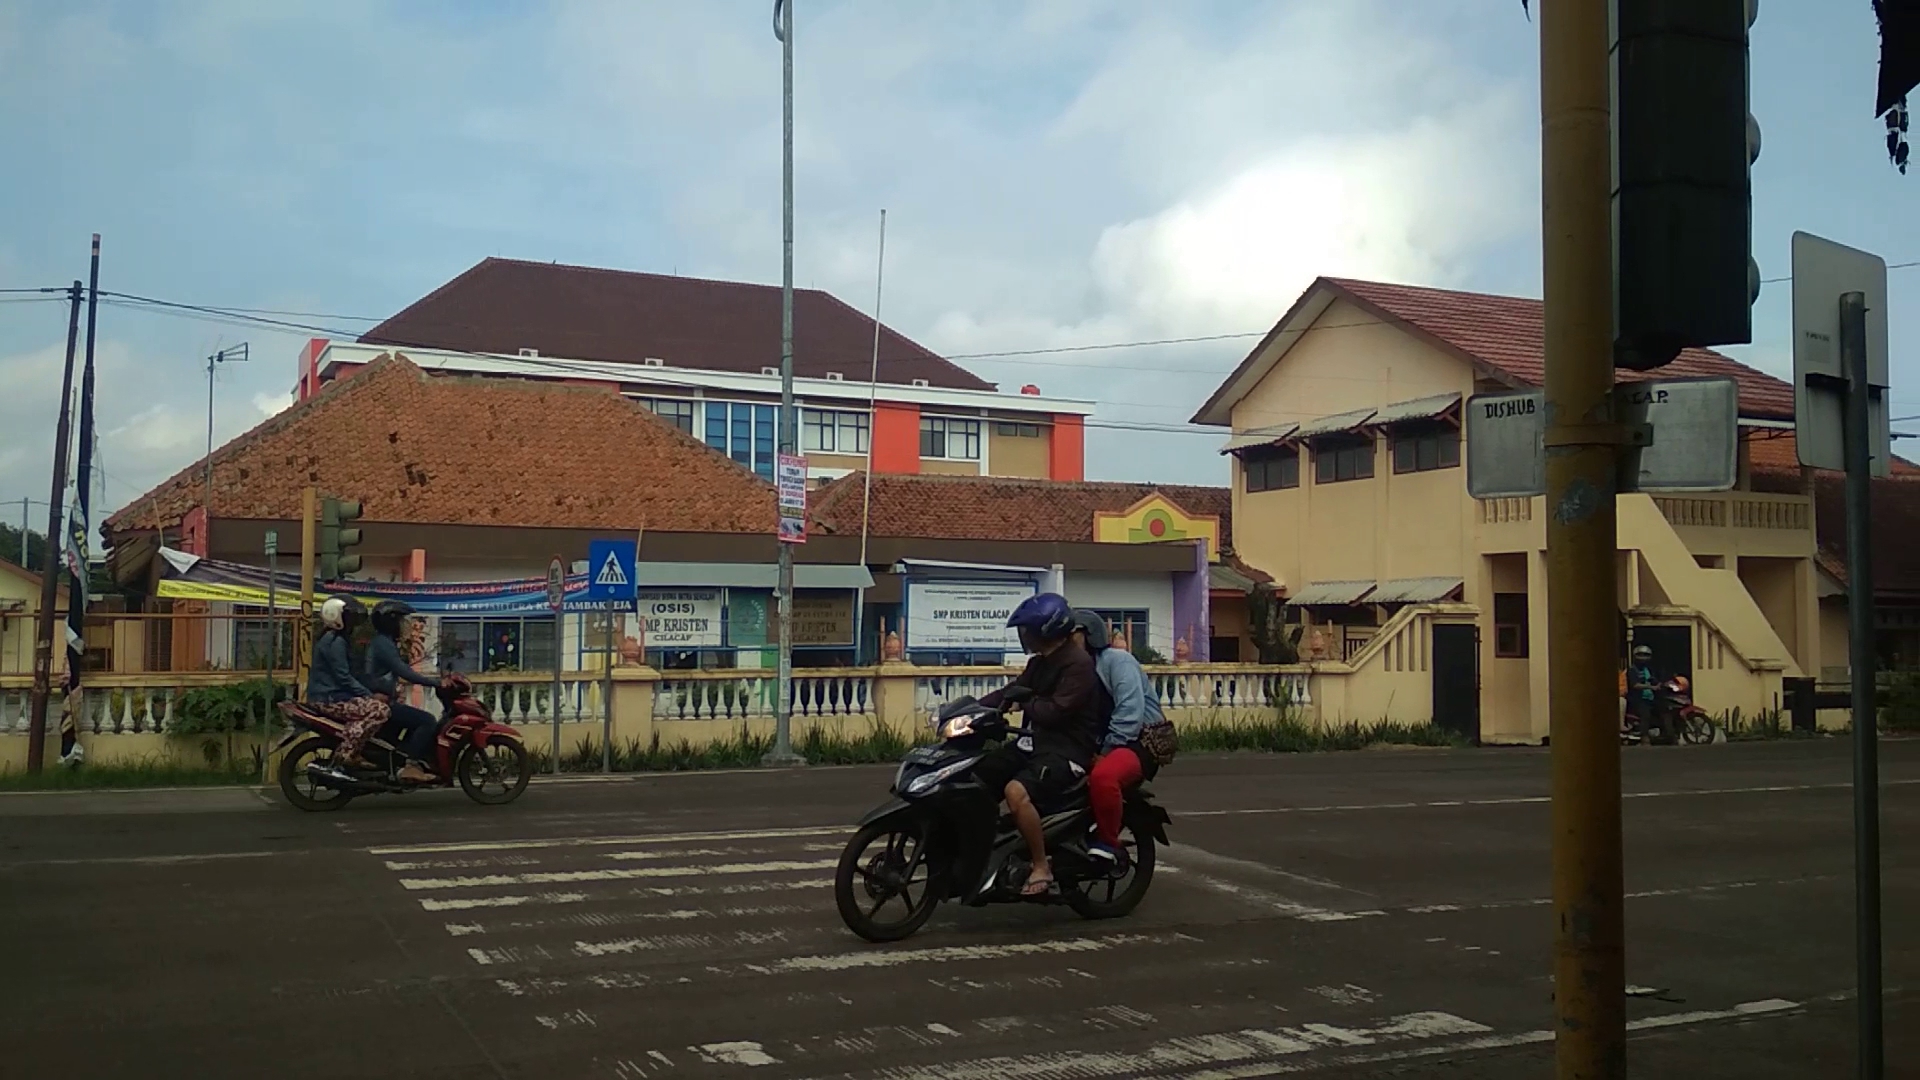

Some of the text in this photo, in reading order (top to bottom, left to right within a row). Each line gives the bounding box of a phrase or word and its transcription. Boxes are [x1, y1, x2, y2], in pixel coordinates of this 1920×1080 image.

[1484, 398, 1536, 419] DISHUB
[563, 600, 633, 611] TAMBAKEJA
[651, 603, 696, 616] (OSIS)
[933, 609, 1010, 620] SMP KRISTEN CILACAP
[639, 618, 709, 633] MP KRISTEN
